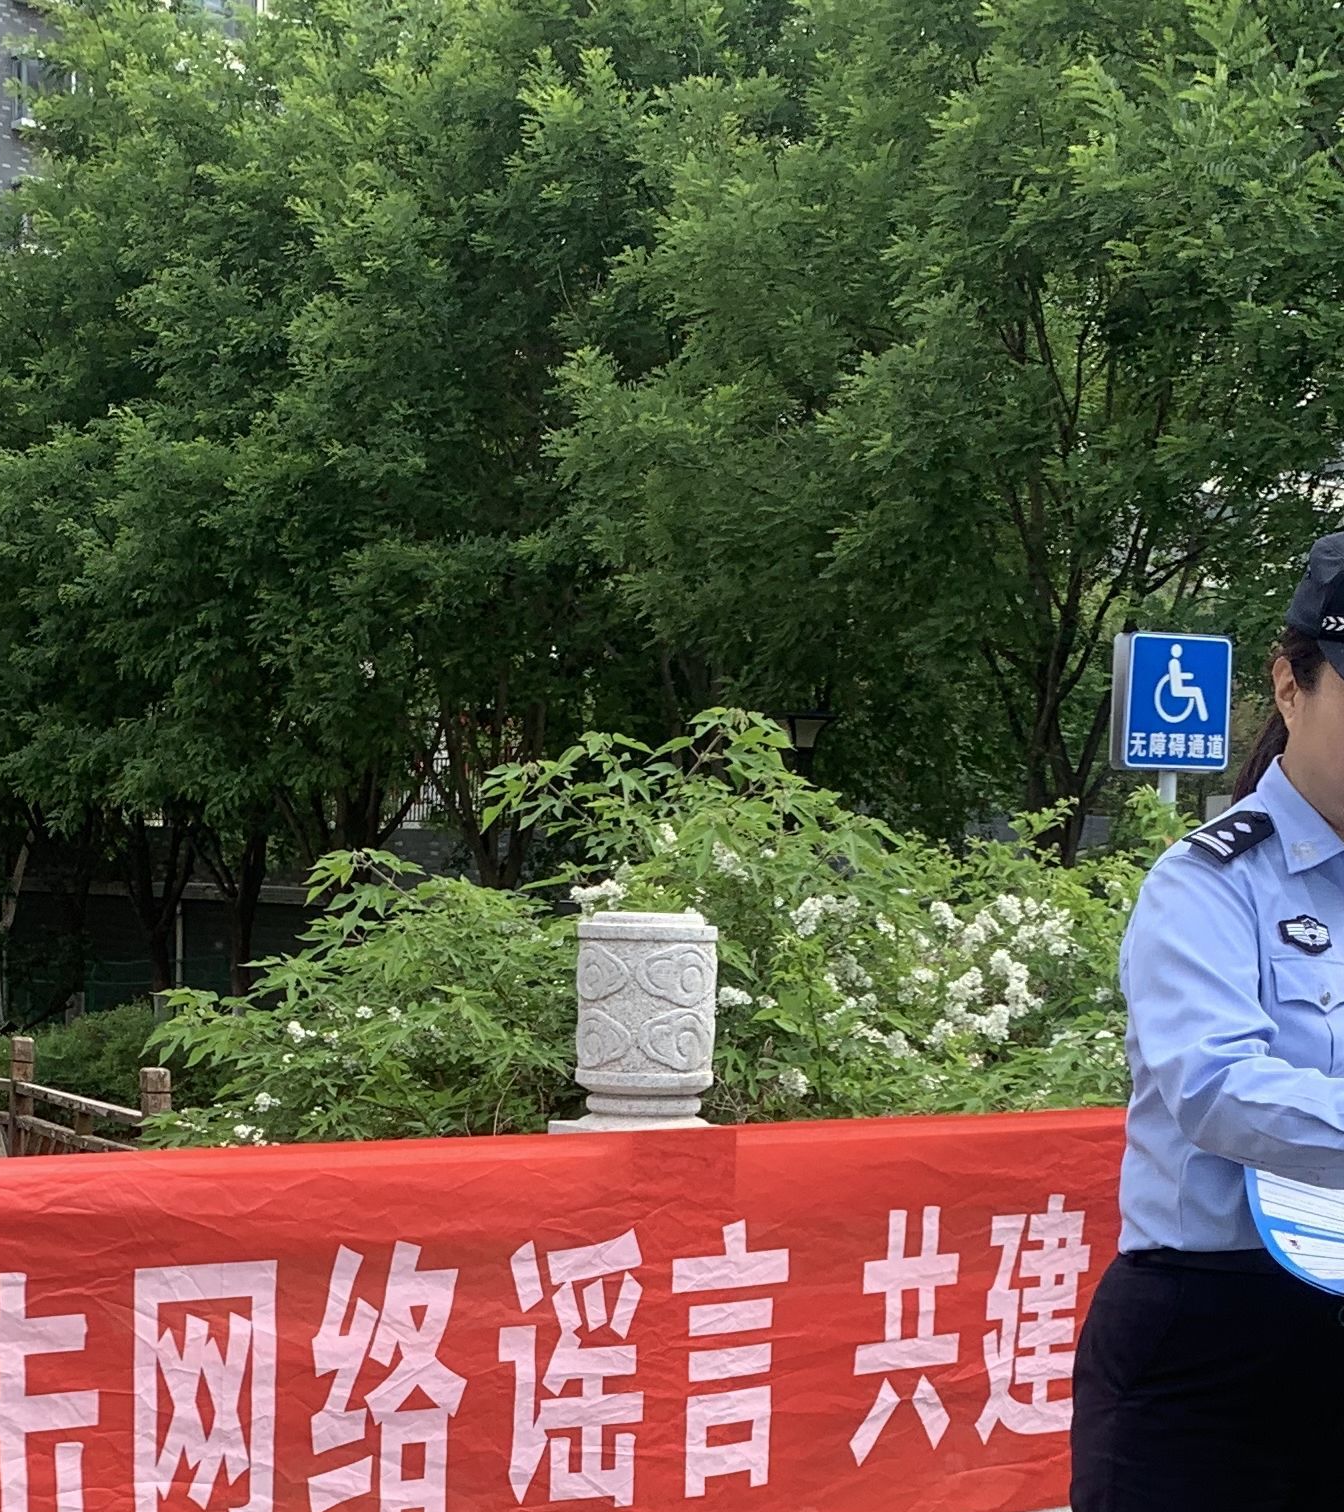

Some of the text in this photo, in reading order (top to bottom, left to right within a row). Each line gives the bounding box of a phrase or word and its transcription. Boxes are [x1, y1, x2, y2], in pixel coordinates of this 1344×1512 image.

[1129, 732, 1224, 759] 无障碍通道
